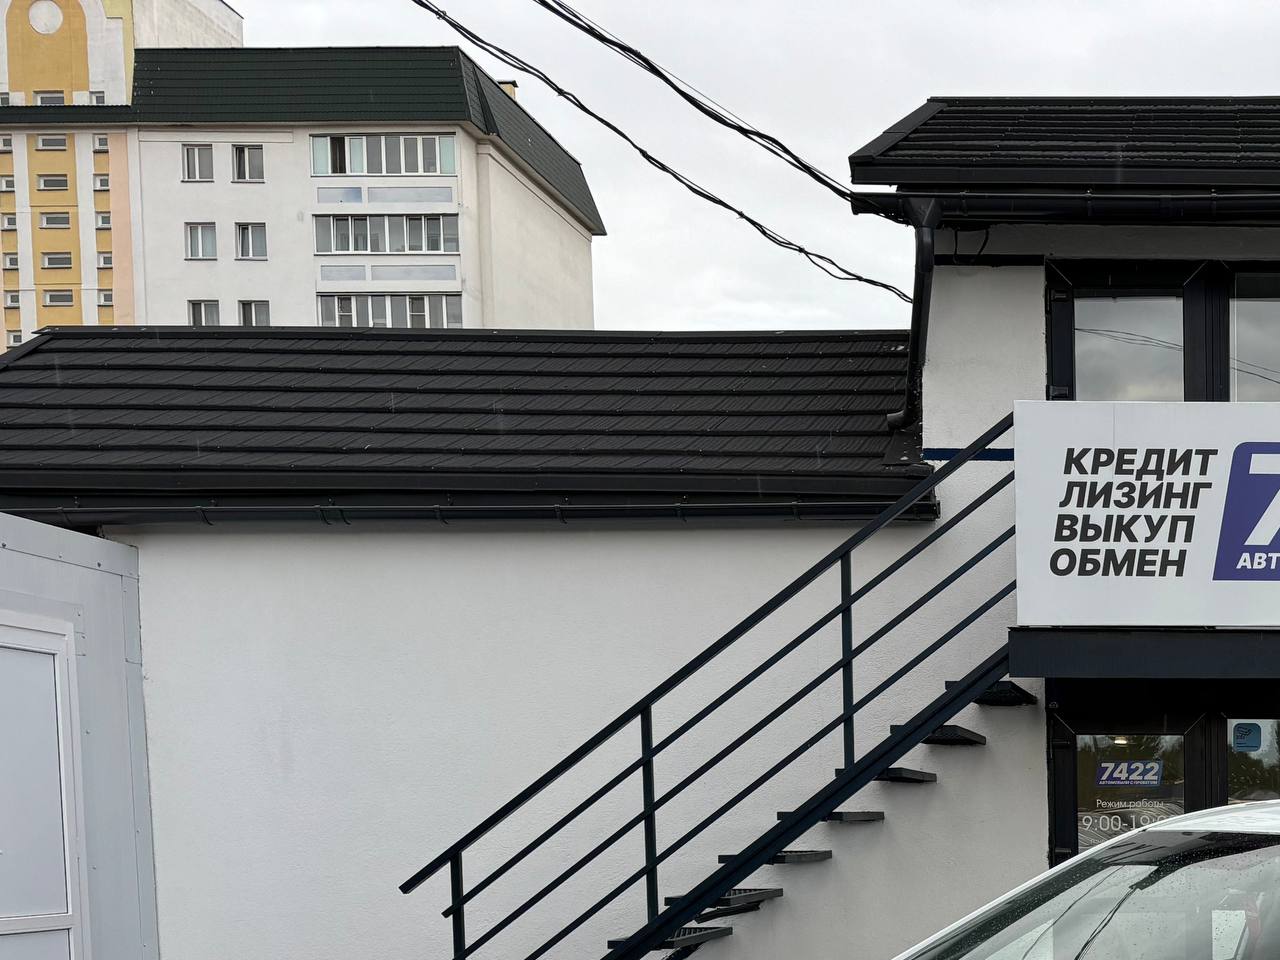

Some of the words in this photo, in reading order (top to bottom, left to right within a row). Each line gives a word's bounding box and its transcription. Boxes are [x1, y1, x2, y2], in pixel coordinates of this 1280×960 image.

[1063, 447, 1219, 482] КРЕДИТ
[1059, 480, 1213, 509] ЛИЗИНГ
[1054, 514, 1196, 544] ВЫКУП
[1049, 548, 1188, 578] ОБМЕН
[1100, 762, 1160, 780] 7422
[1096, 798, 1127, 808] Режим
[1130, 798, 1164, 810] работы
